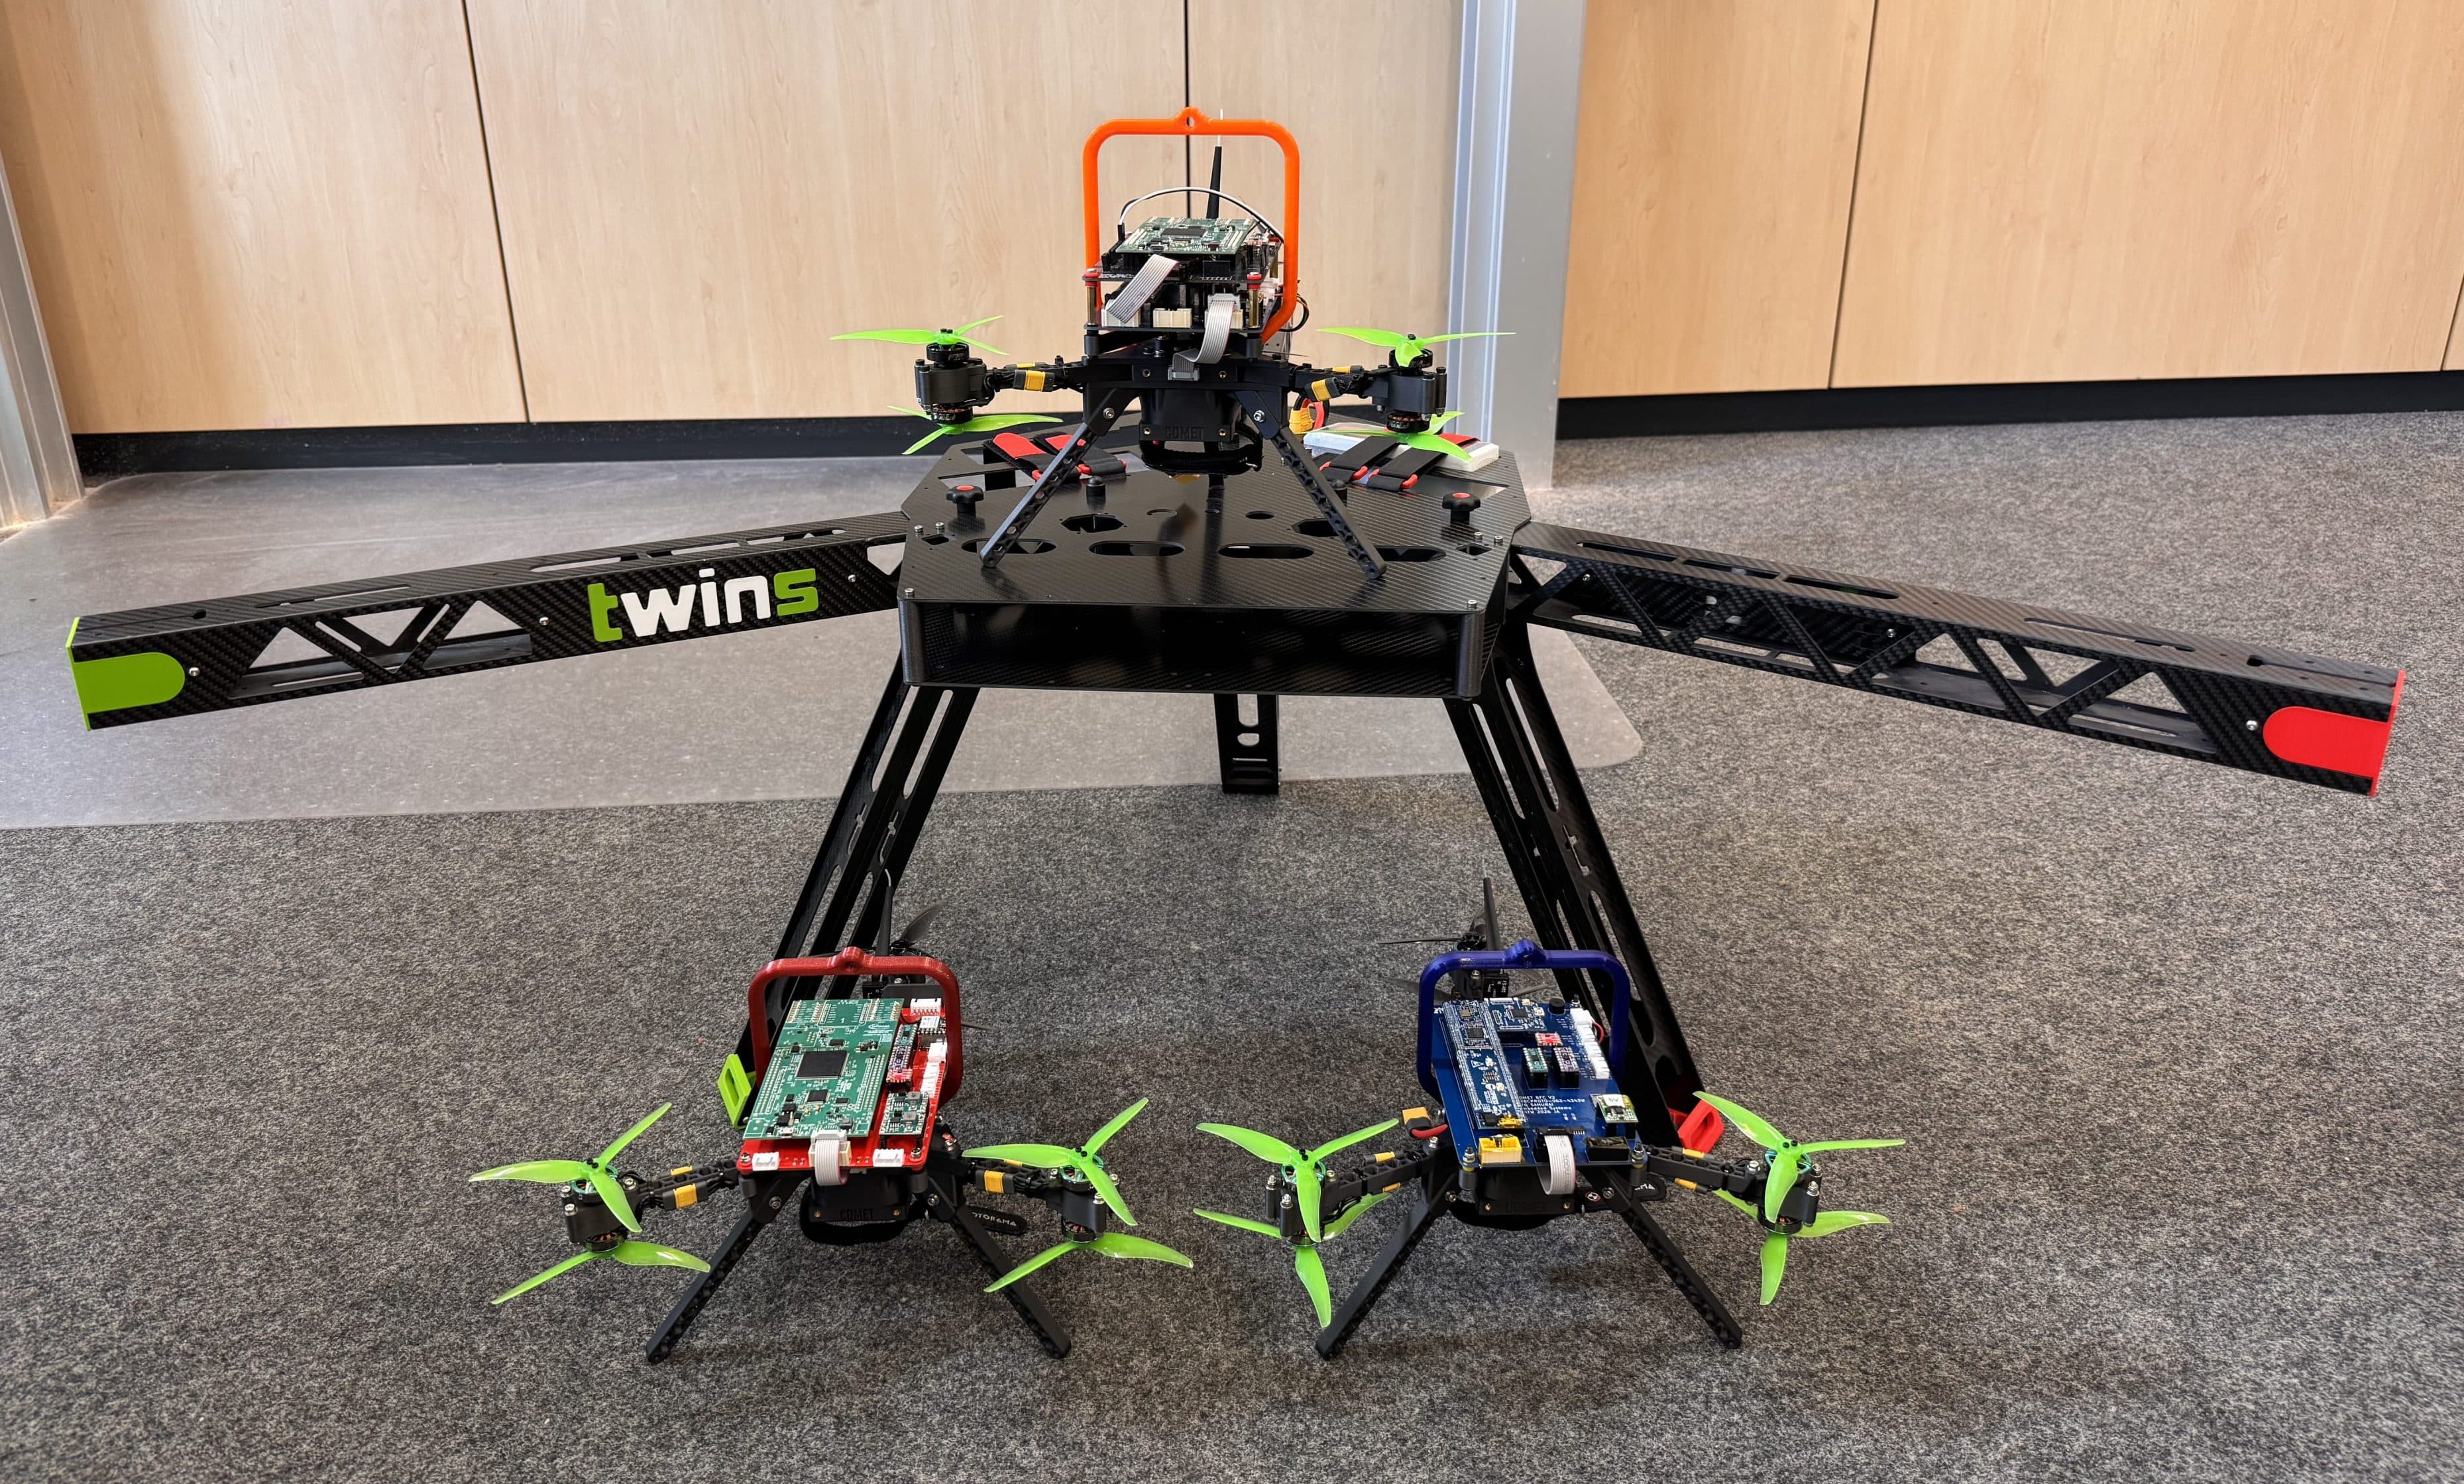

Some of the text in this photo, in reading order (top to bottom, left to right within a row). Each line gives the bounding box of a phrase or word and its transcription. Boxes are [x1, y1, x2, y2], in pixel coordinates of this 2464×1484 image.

[1165, 425, 1204, 439] COMET
[587, 568, 819, 643] twins
[839, 1208, 874, 1220] COMET
[972, 1211, 1017, 1227] OTORAMA
